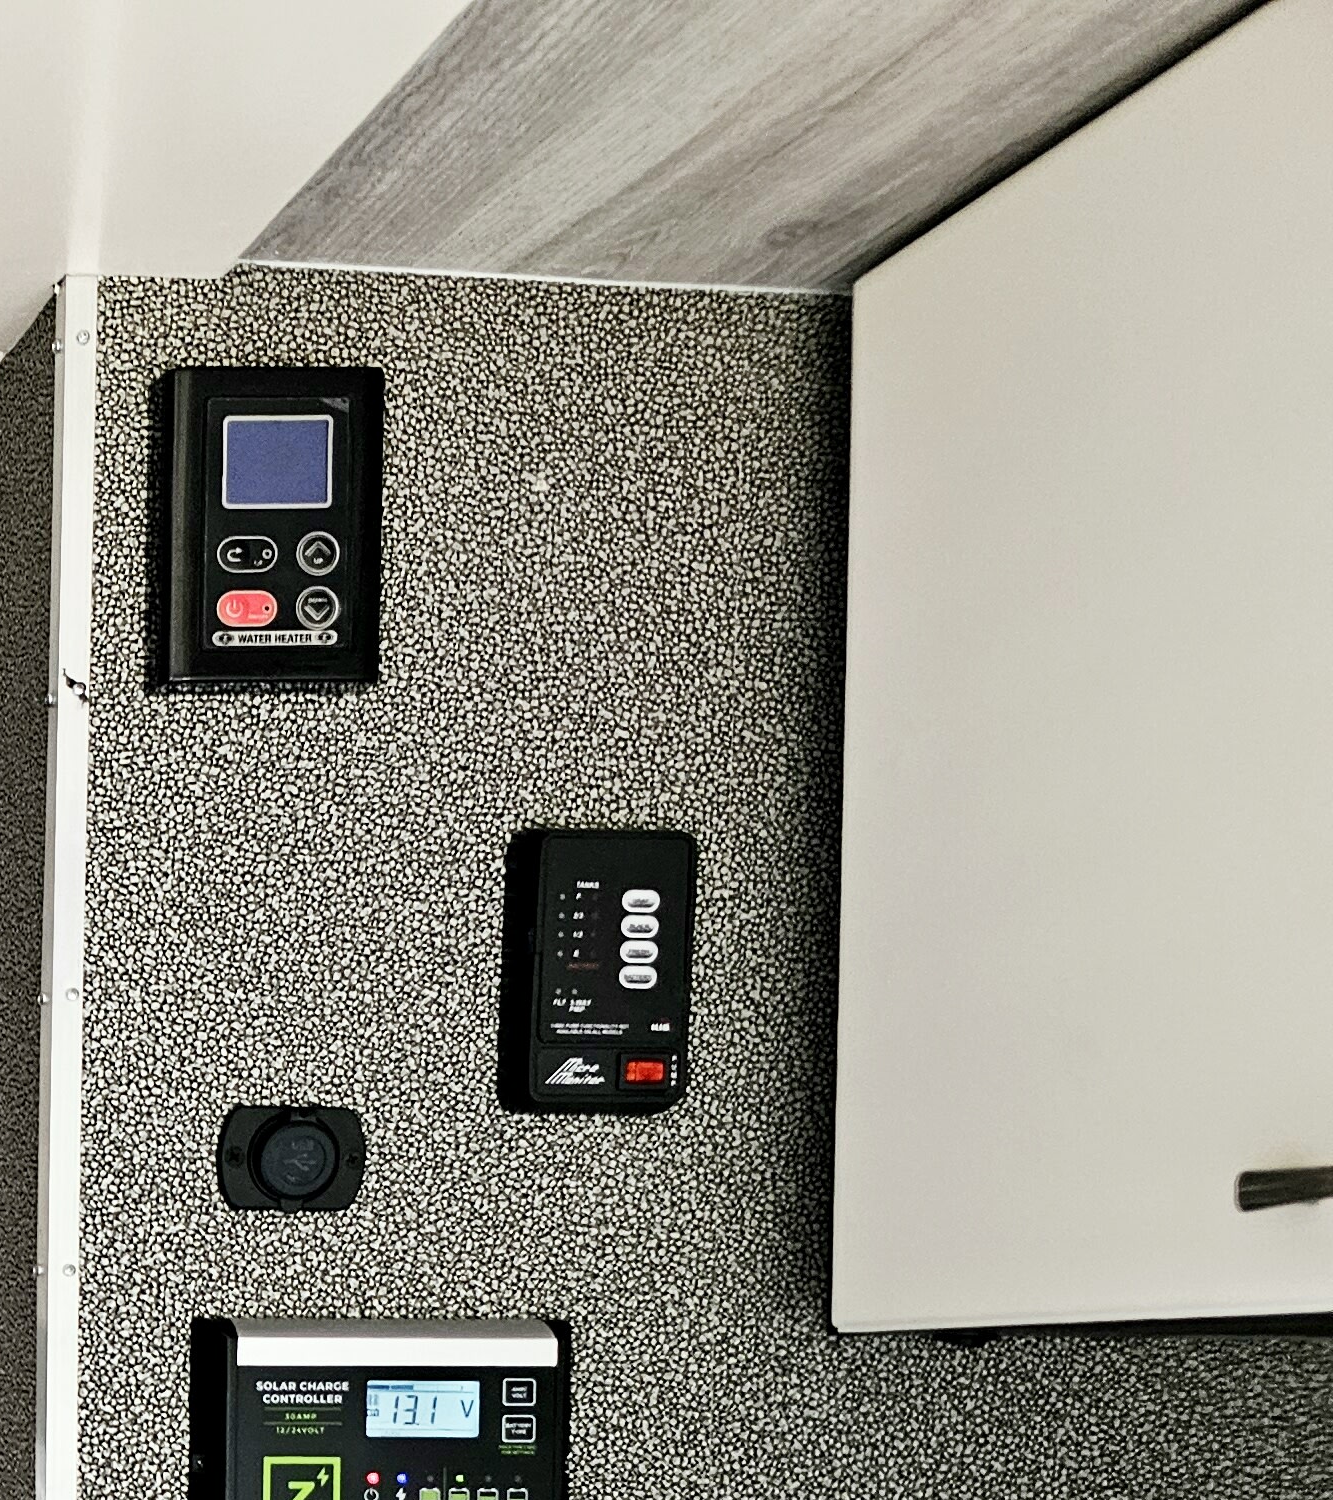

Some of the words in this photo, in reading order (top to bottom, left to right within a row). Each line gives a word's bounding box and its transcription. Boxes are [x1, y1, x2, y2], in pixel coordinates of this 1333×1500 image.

[238, 634, 271, 643] WATER
[275, 634, 312, 643] HEATER
[255, 1381, 296, 1391] SOLAR
[299, 1381, 349, 1391] CHARGE
[262, 1394, 343, 1404] CONTROLLER
[460, 1399, 475, 1418] V
